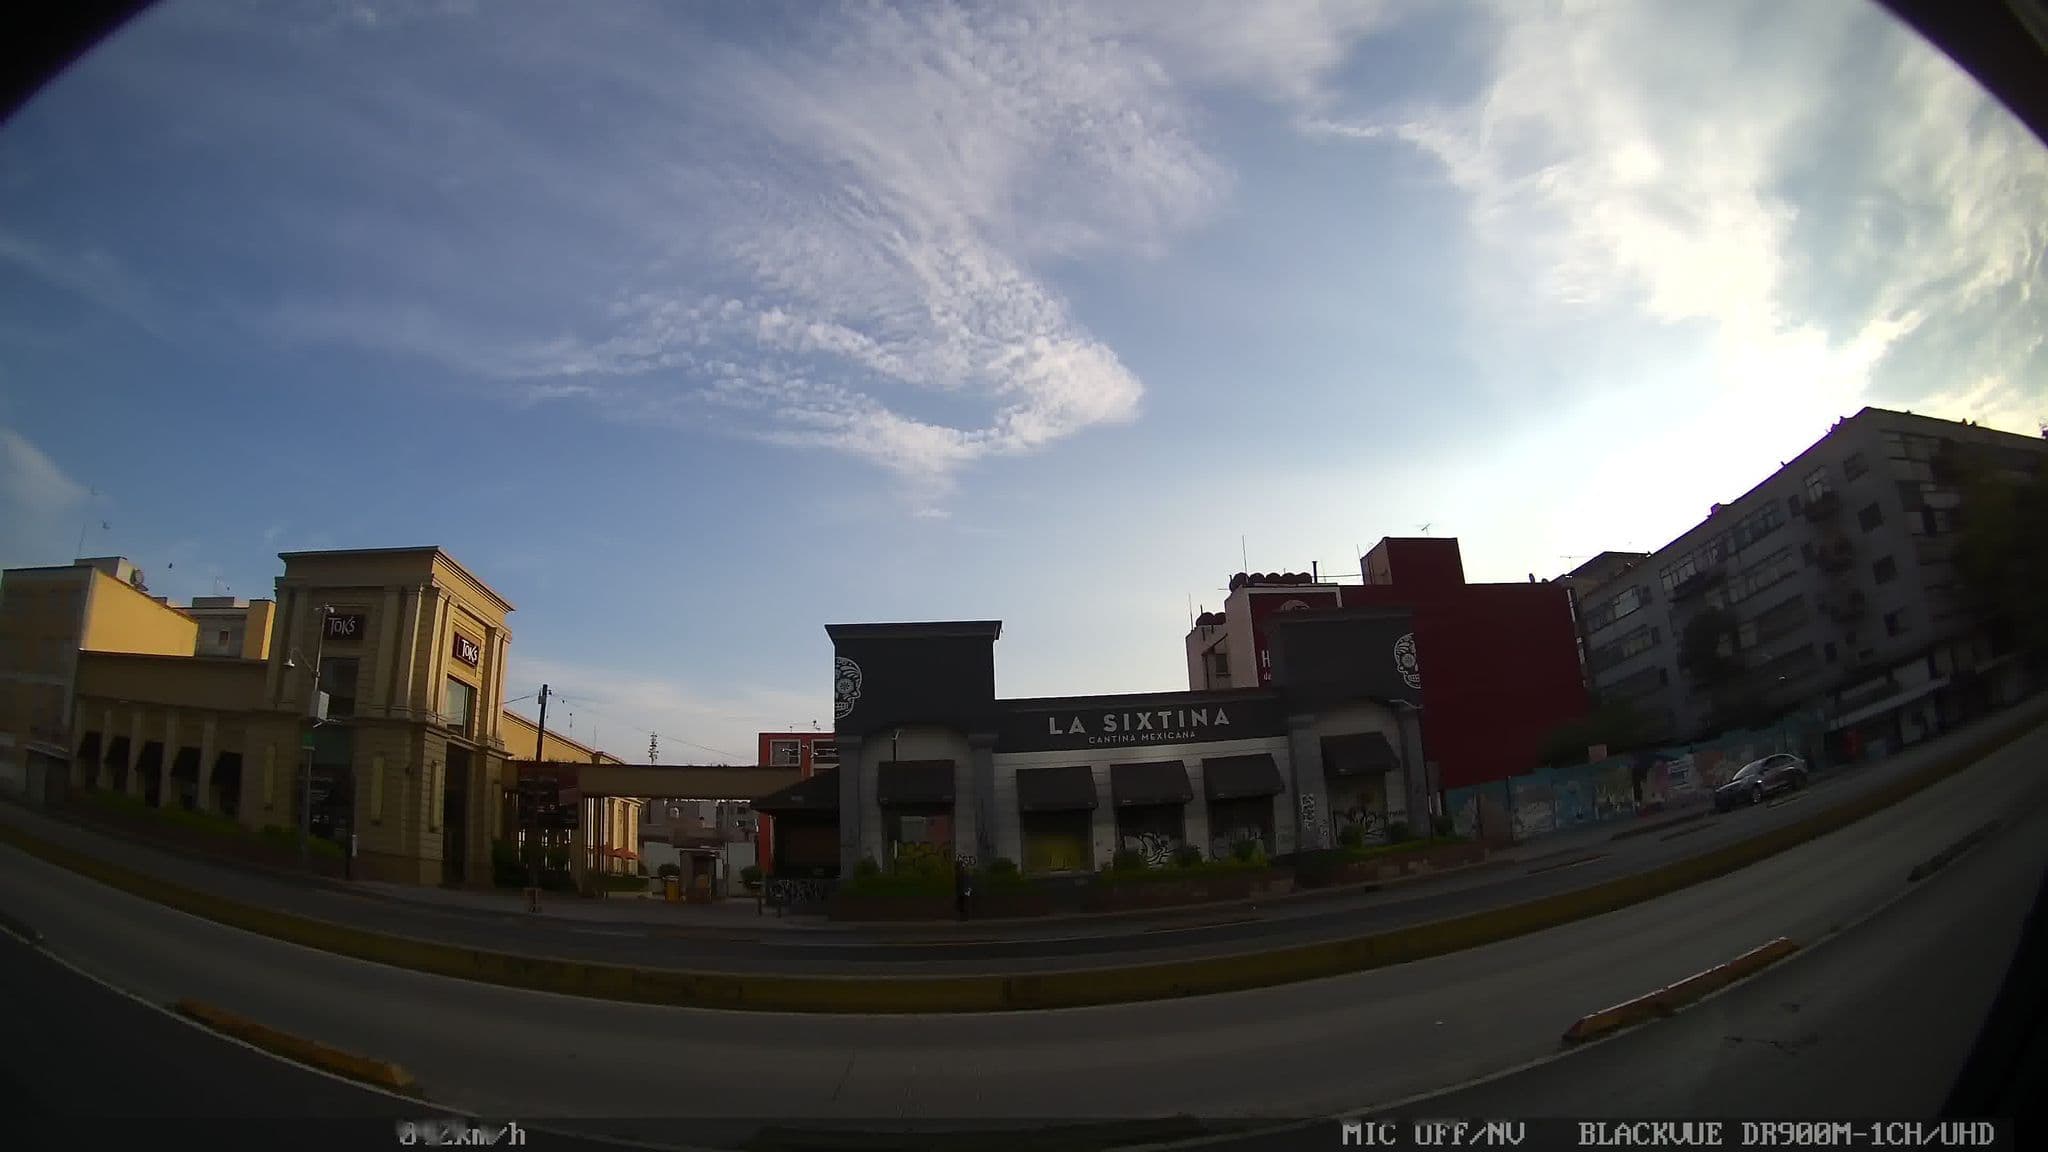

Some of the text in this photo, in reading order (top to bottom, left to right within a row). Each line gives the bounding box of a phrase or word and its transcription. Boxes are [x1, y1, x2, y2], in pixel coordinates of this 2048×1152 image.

[1049, 707, 1230, 735] LA SIXTINA
[1088, 730, 1196, 745] CANTINA MEXICANA
